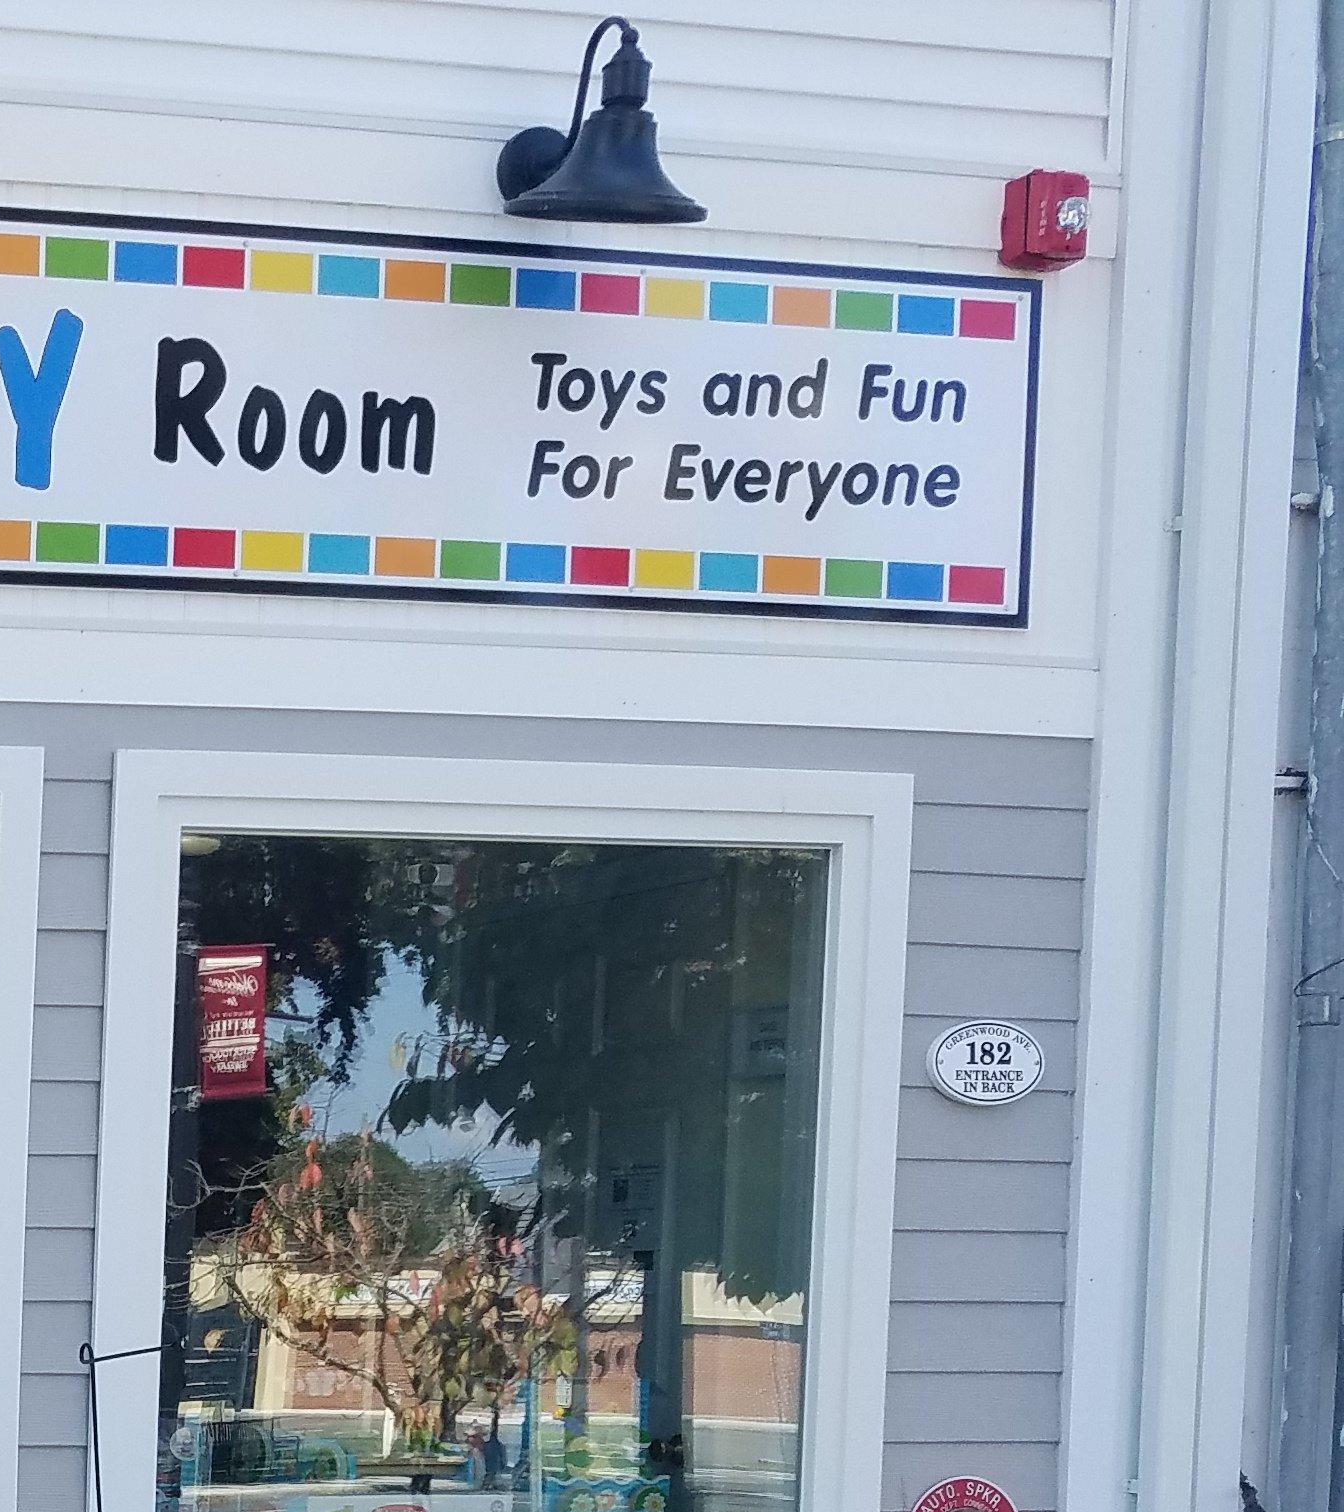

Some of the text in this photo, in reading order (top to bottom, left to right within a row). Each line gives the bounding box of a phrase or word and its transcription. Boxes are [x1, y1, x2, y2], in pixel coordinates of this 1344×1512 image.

[531, 352, 967, 430] Toys and Fun
[153, 335, 437, 475] Room
[527, 440, 961, 521] For Everyone
[945, 1026, 1011, 1051] GREENWOOD
[966, 1041, 1012, 1065] 182
[955, 1069, 1024, 1081] ENTRANCE
[963, 1082, 1015, 1093] IN BACK
